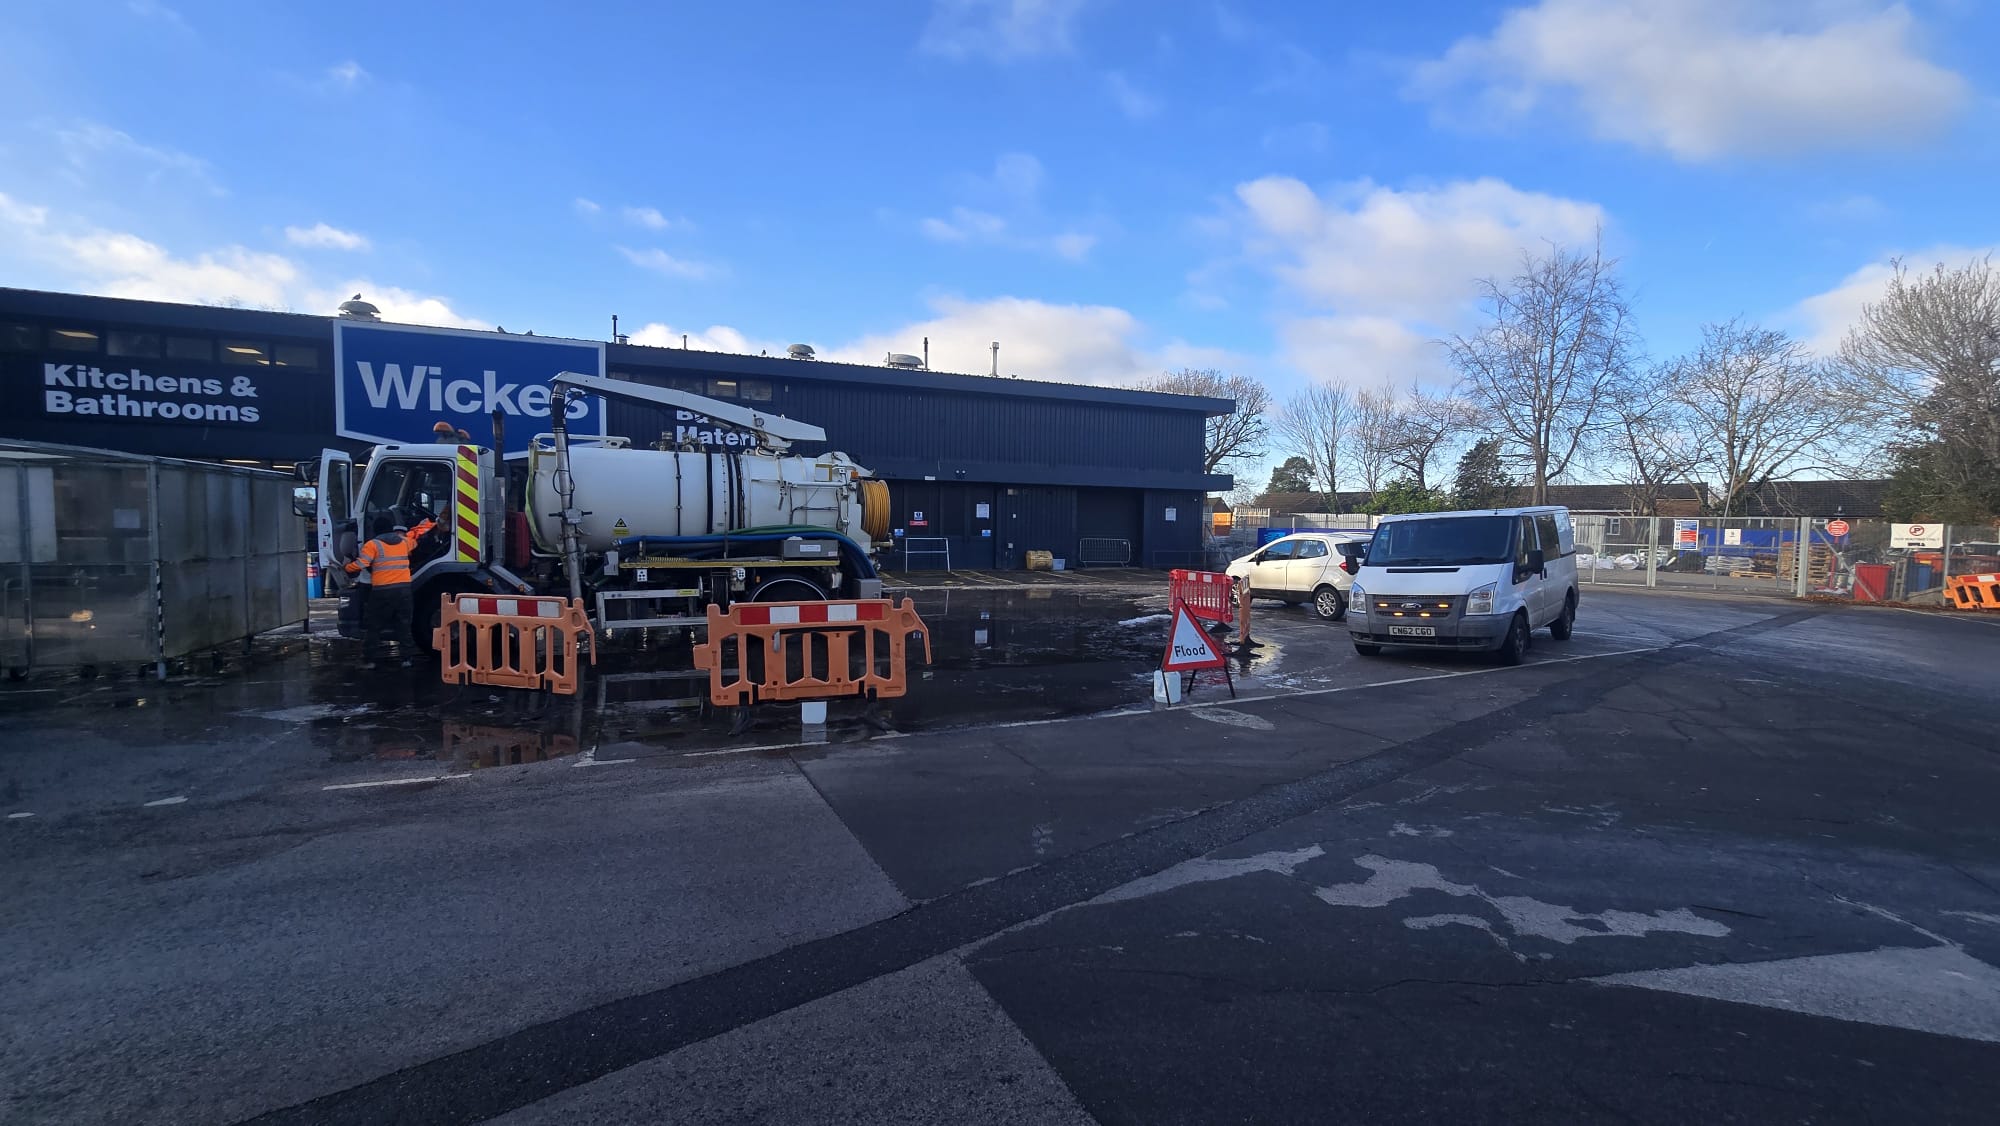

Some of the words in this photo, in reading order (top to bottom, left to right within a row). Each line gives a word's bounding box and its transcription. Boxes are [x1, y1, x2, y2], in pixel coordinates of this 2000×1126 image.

[44, 363, 223, 396] Kitchens
[230, 375, 259, 398] &
[356, 360, 589, 420] Wickes
[45, 390, 260, 423] Bathrooms
[1392, 627, 1413, 635] CN62
[1174, 643, 1206, 658] Flood
